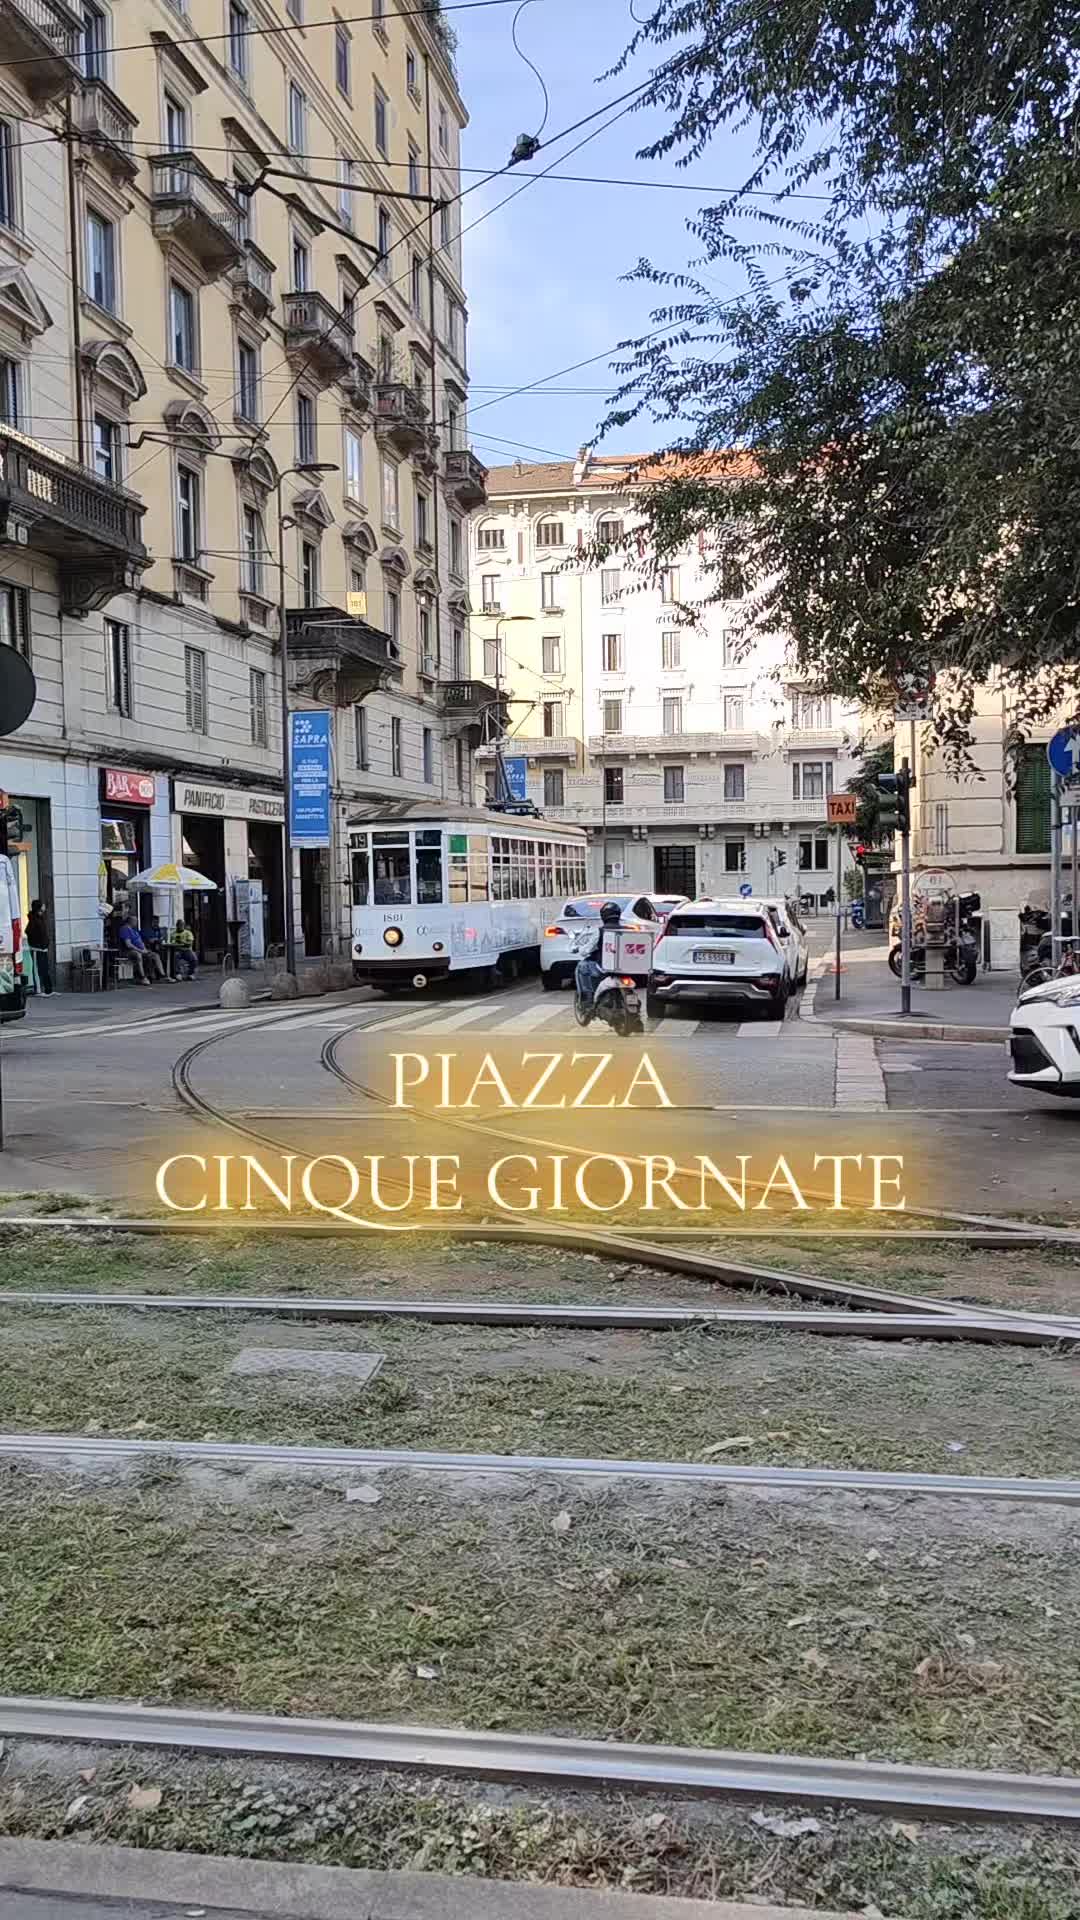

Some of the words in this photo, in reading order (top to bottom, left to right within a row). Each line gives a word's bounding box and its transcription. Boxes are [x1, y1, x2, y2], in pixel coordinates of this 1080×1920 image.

[293, 734, 328, 745] SAPRA
[106, 772, 132, 797] BAR
[829, 802, 855, 816] TAXI
